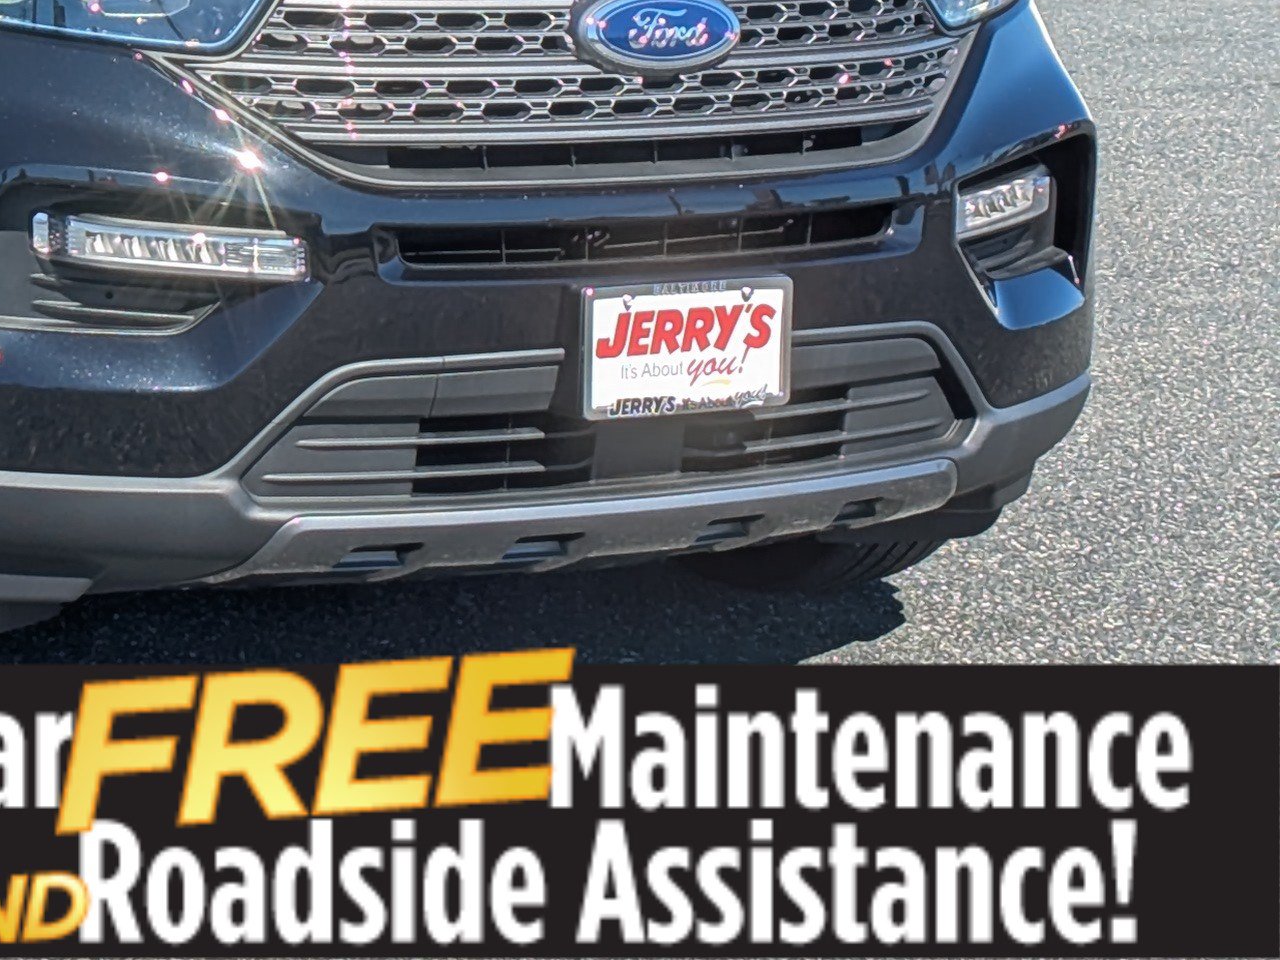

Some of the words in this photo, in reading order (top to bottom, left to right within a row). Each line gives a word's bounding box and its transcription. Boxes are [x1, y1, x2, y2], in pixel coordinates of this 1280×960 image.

[628, 7, 709, 49] Ford
[596, 303, 777, 359] JERRY'S
[620, 363, 638, 380] It's
[641, 360, 684, 378] About
[686, 347, 748, 387] you!
